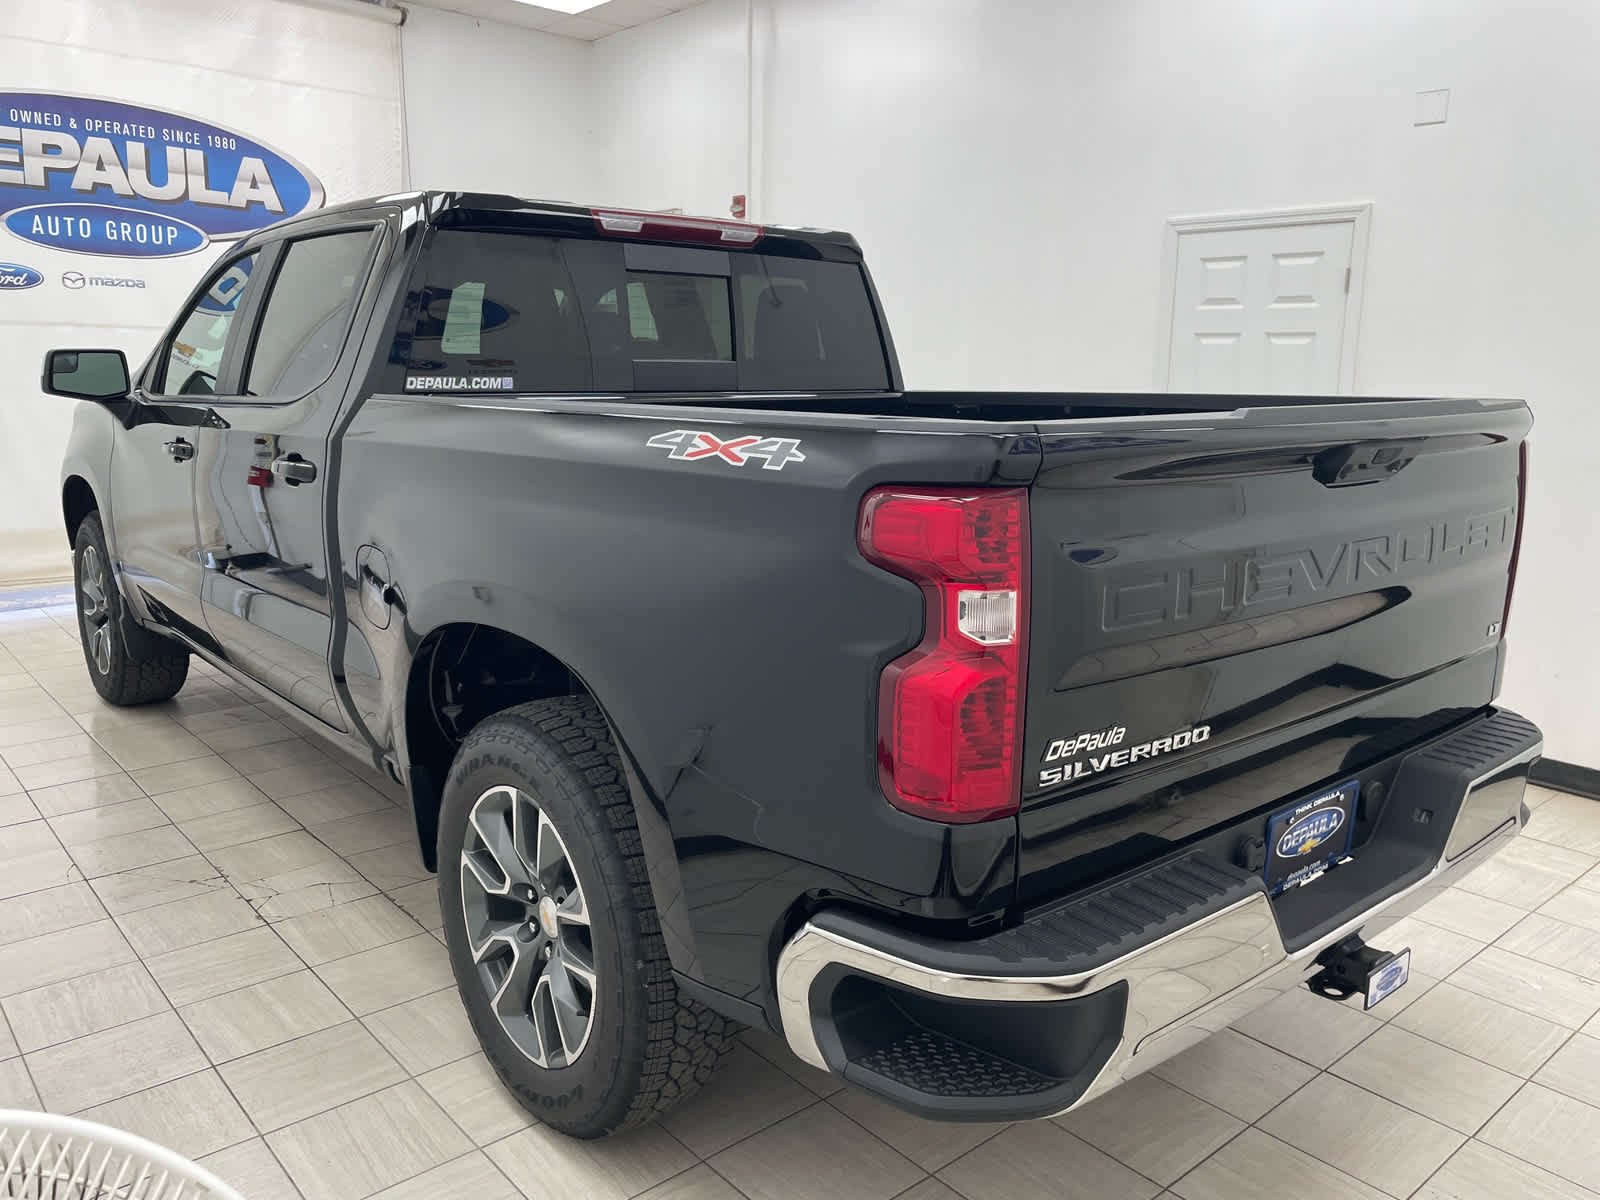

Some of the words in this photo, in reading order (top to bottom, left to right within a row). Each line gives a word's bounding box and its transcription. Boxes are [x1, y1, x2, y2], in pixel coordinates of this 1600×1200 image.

[9, 107, 62, 127] OWNED
[69, 117, 78, 129] &
[84, 118, 156, 140] OPERATED
[162, 128, 201, 146] SINCE
[207, 135, 237, 151] 1980
[31, 214, 92, 239] AUTO
[105, 220, 179, 246] GROUP
[88, 276, 146, 289] mazda
[405, 376, 502, 390] DEPAULA.COM
[1100, 505, 1516, 634] CHEVROLET
[1038, 724, 1212, 788] SILVERADO
[1044, 726, 1127, 763] DePaula
[1281, 812, 1339, 853] DEPAULA
